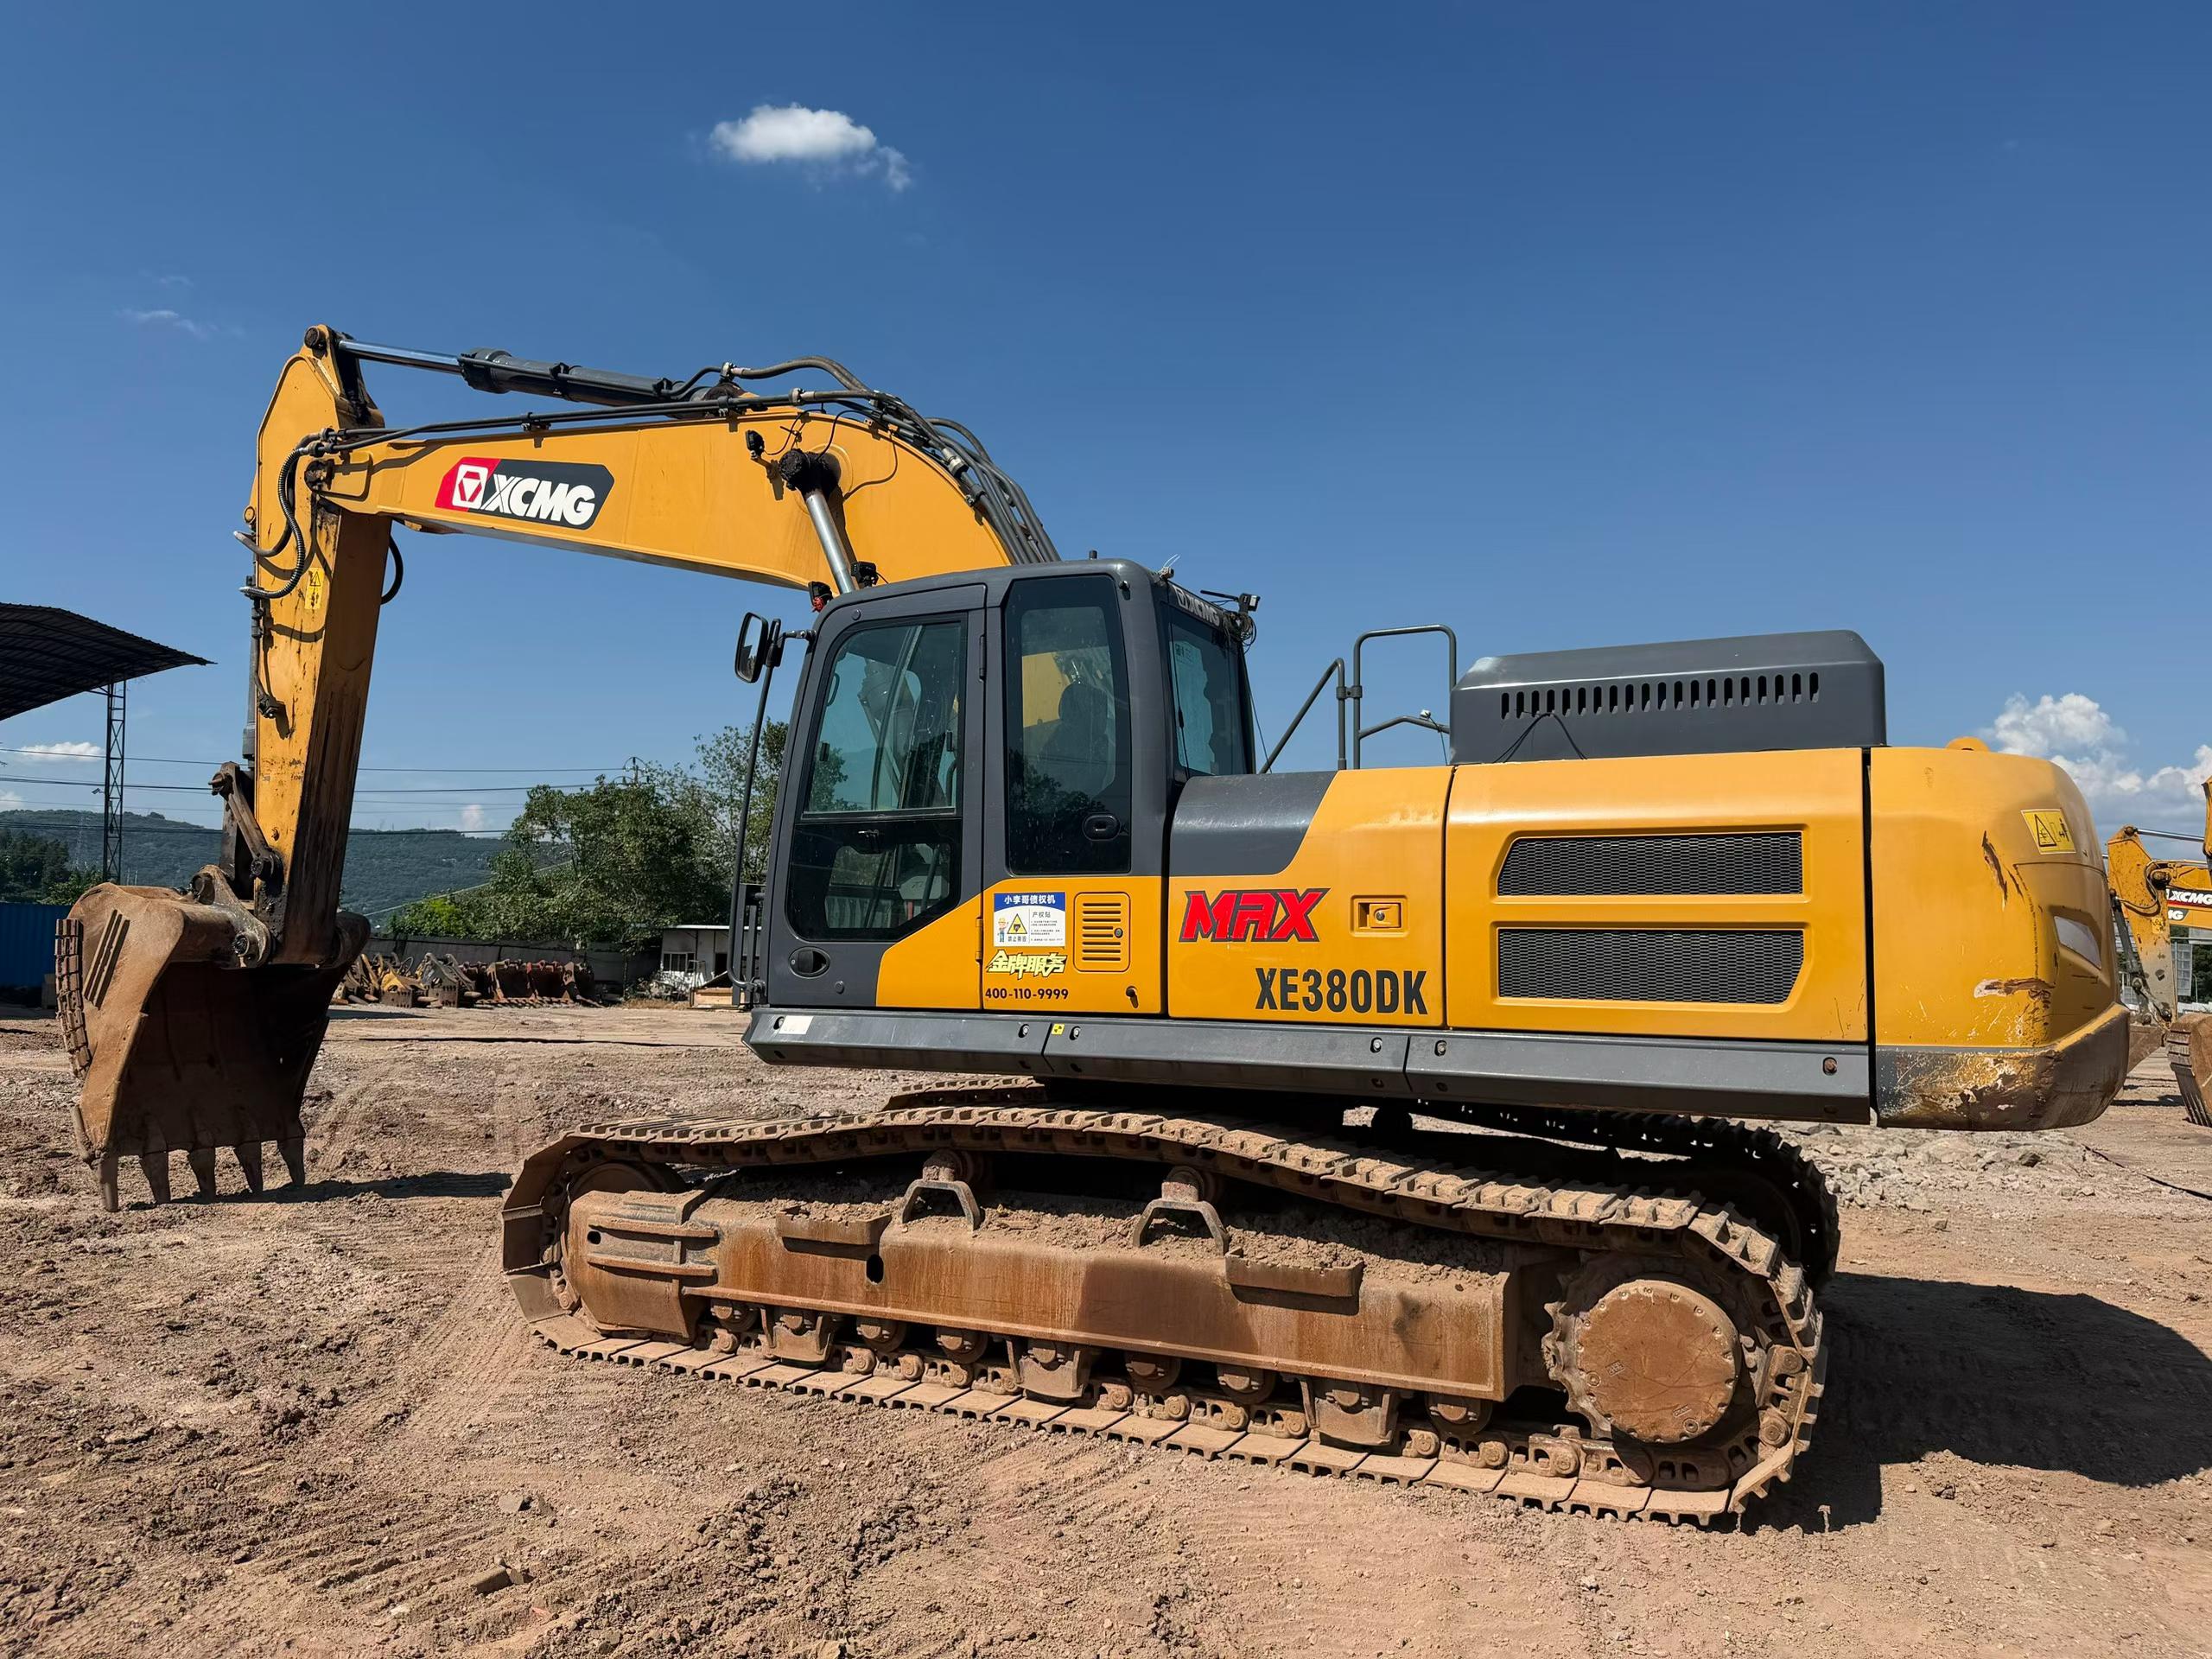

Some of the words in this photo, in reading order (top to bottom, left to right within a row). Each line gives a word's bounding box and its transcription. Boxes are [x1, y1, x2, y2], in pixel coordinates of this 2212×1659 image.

[480, 474, 596, 526] XCMG
[1004, 894, 1056, 905] 小李哥债权机
[2168, 890, 2212, 906] XCMG
[1178, 888, 1332, 943] MAX
[987, 950, 1068, 981] 金牌服务
[985, 988, 1070, 1000] 400-110-9999
[1255, 967, 1428, 1015] XE380DK
